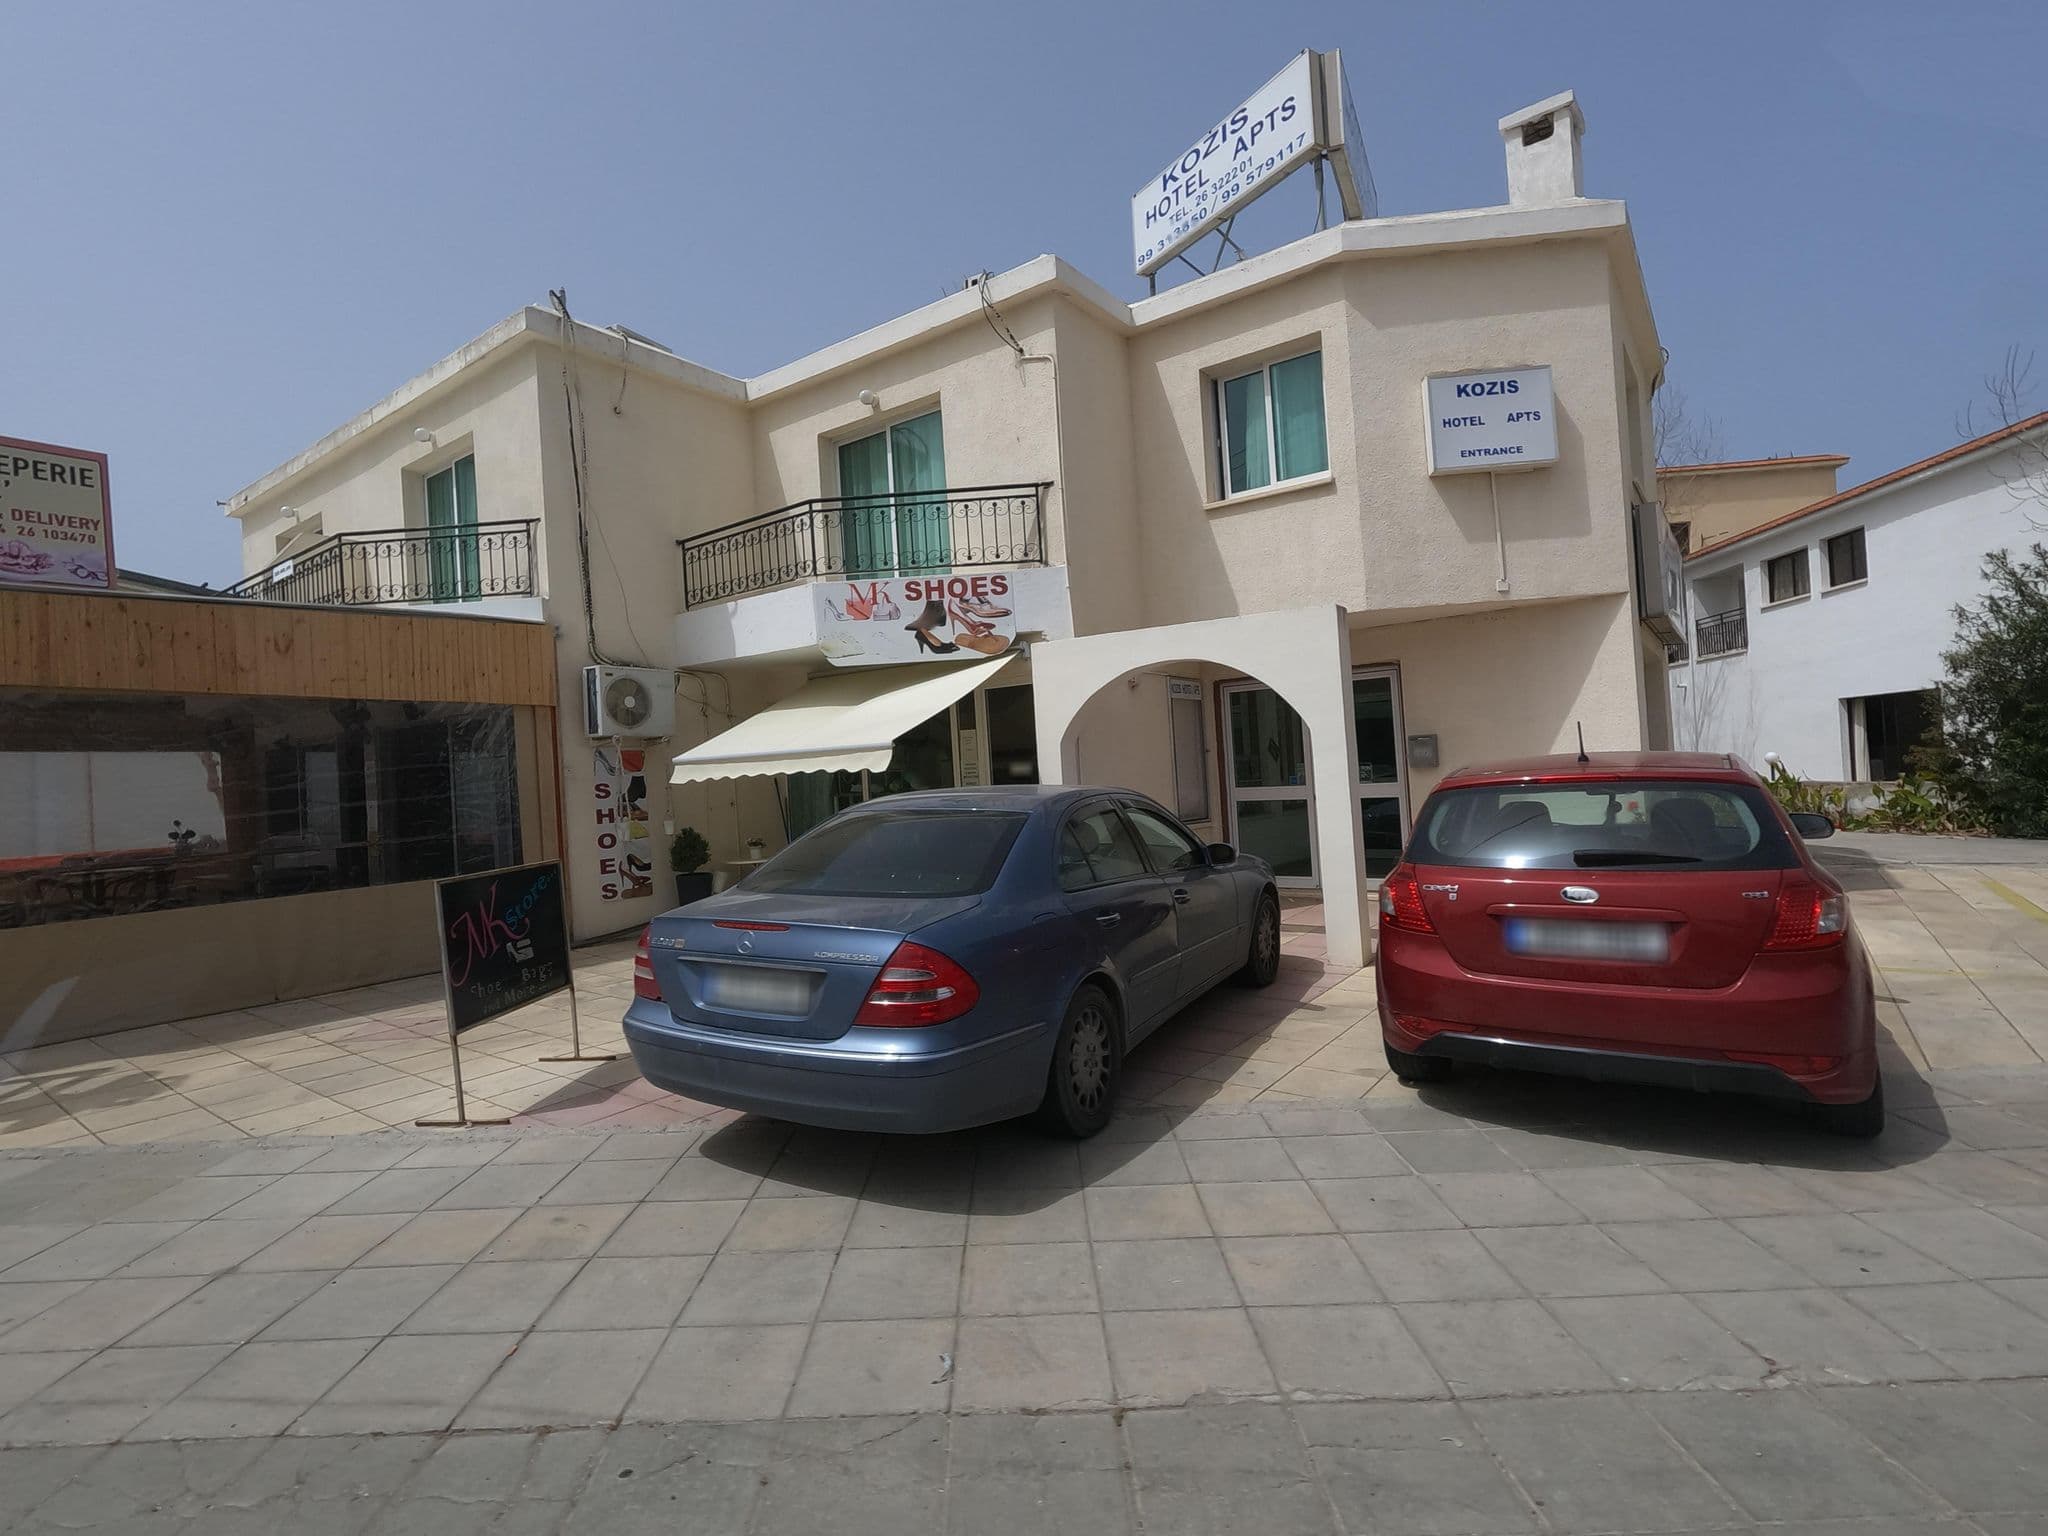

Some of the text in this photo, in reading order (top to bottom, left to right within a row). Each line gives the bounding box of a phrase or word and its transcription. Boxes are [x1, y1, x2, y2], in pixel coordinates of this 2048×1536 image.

[1145, 96, 1297, 229] HOTEL APTS
[1162, 107, 1249, 192] KOZIS
[1195, 191, 1209, 207] 26
[1211, 156, 1254, 195] 322201
[1137, 248, 1154, 267] 99
[1222, 182, 1241, 204] 99
[1245, 132, 1307, 186] 579117
[1456, 380, 1520, 398] KOZIS
[1442, 410, 1542, 428] HOTEL APTS
[1460, 445, 1524, 458] ENTRANCE
[10, 508, 101, 531] DELIVERY
[16, 525, 36, 537] 26
[904, 574, 1009, 602] SHOES
[594, 784, 611, 899] SHOES
